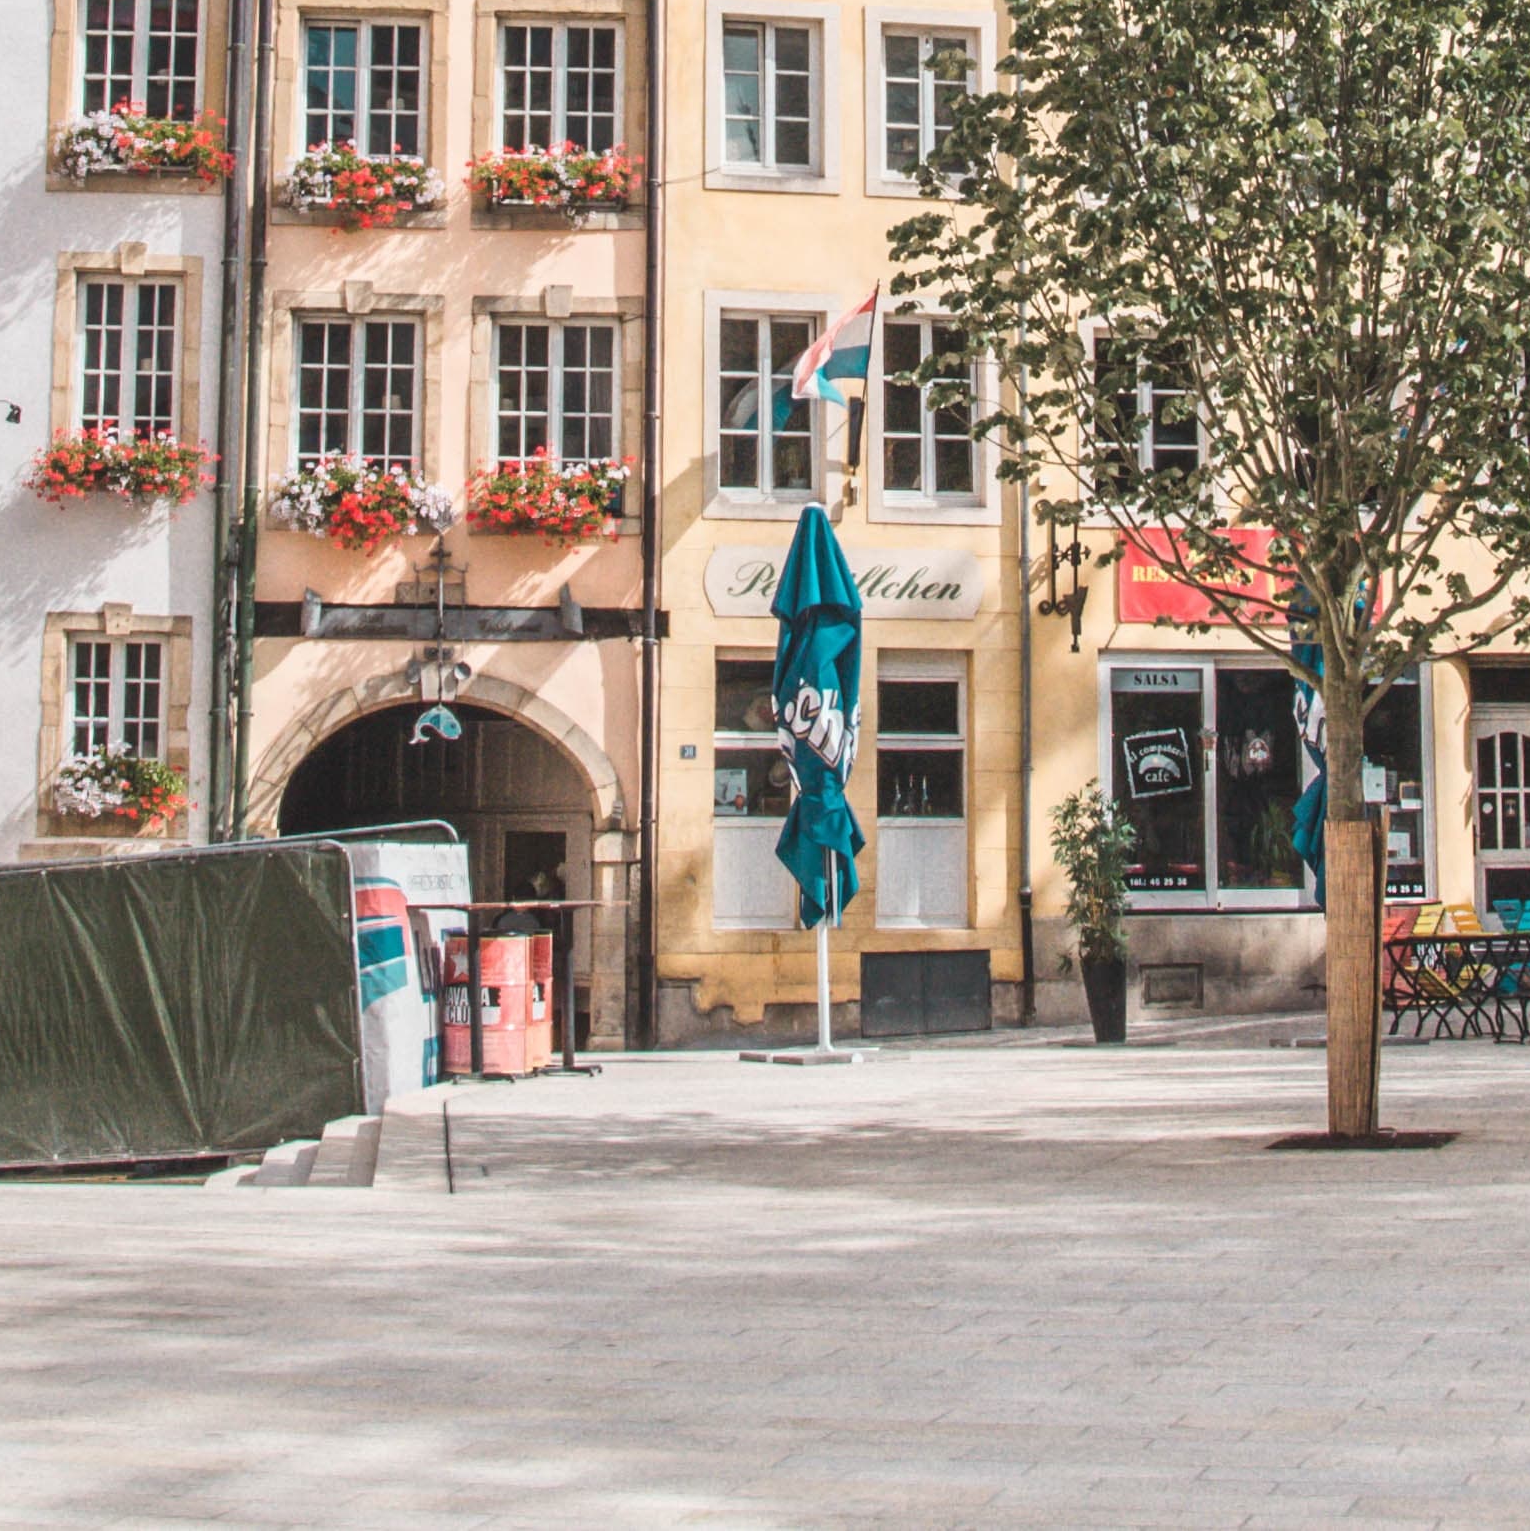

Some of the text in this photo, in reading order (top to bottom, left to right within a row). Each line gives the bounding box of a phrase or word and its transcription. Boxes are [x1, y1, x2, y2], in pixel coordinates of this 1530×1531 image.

[1133, 673, 1179, 686] SALSA
[445, 985, 491, 1008] AVAA
[449, 1006, 470, 1024] CLU
